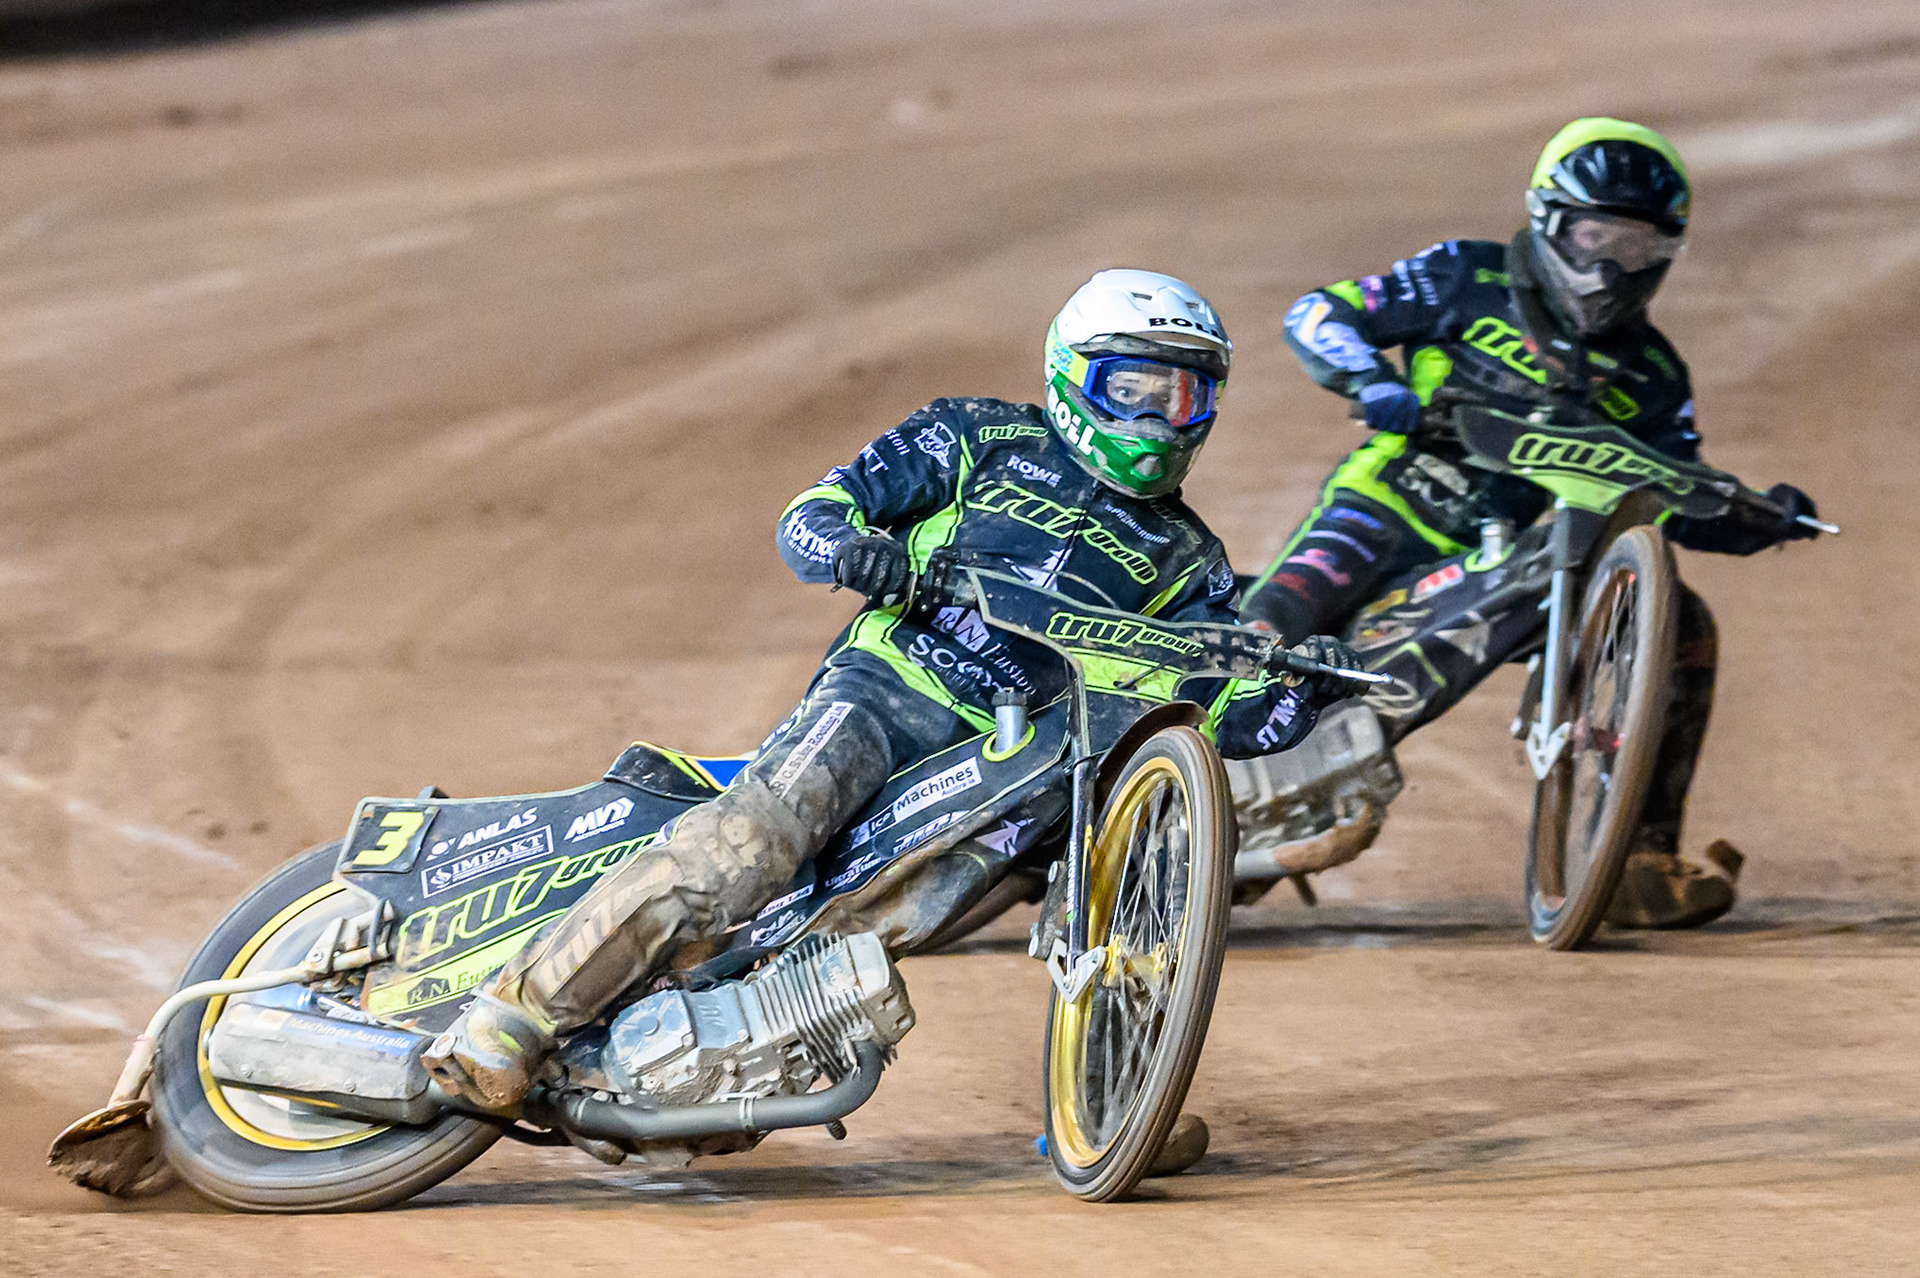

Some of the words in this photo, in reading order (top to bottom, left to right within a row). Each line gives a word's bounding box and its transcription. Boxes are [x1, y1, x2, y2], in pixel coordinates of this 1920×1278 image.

[1006, 454, 1063, 488] ROWE
[896, 765, 974, 811] Machines
[352, 812, 424, 865] 3
[457, 807, 538, 850] ANLAS
[452, 833, 544, 874] IMPAKT
[456, 959, 512, 990] Eusto
